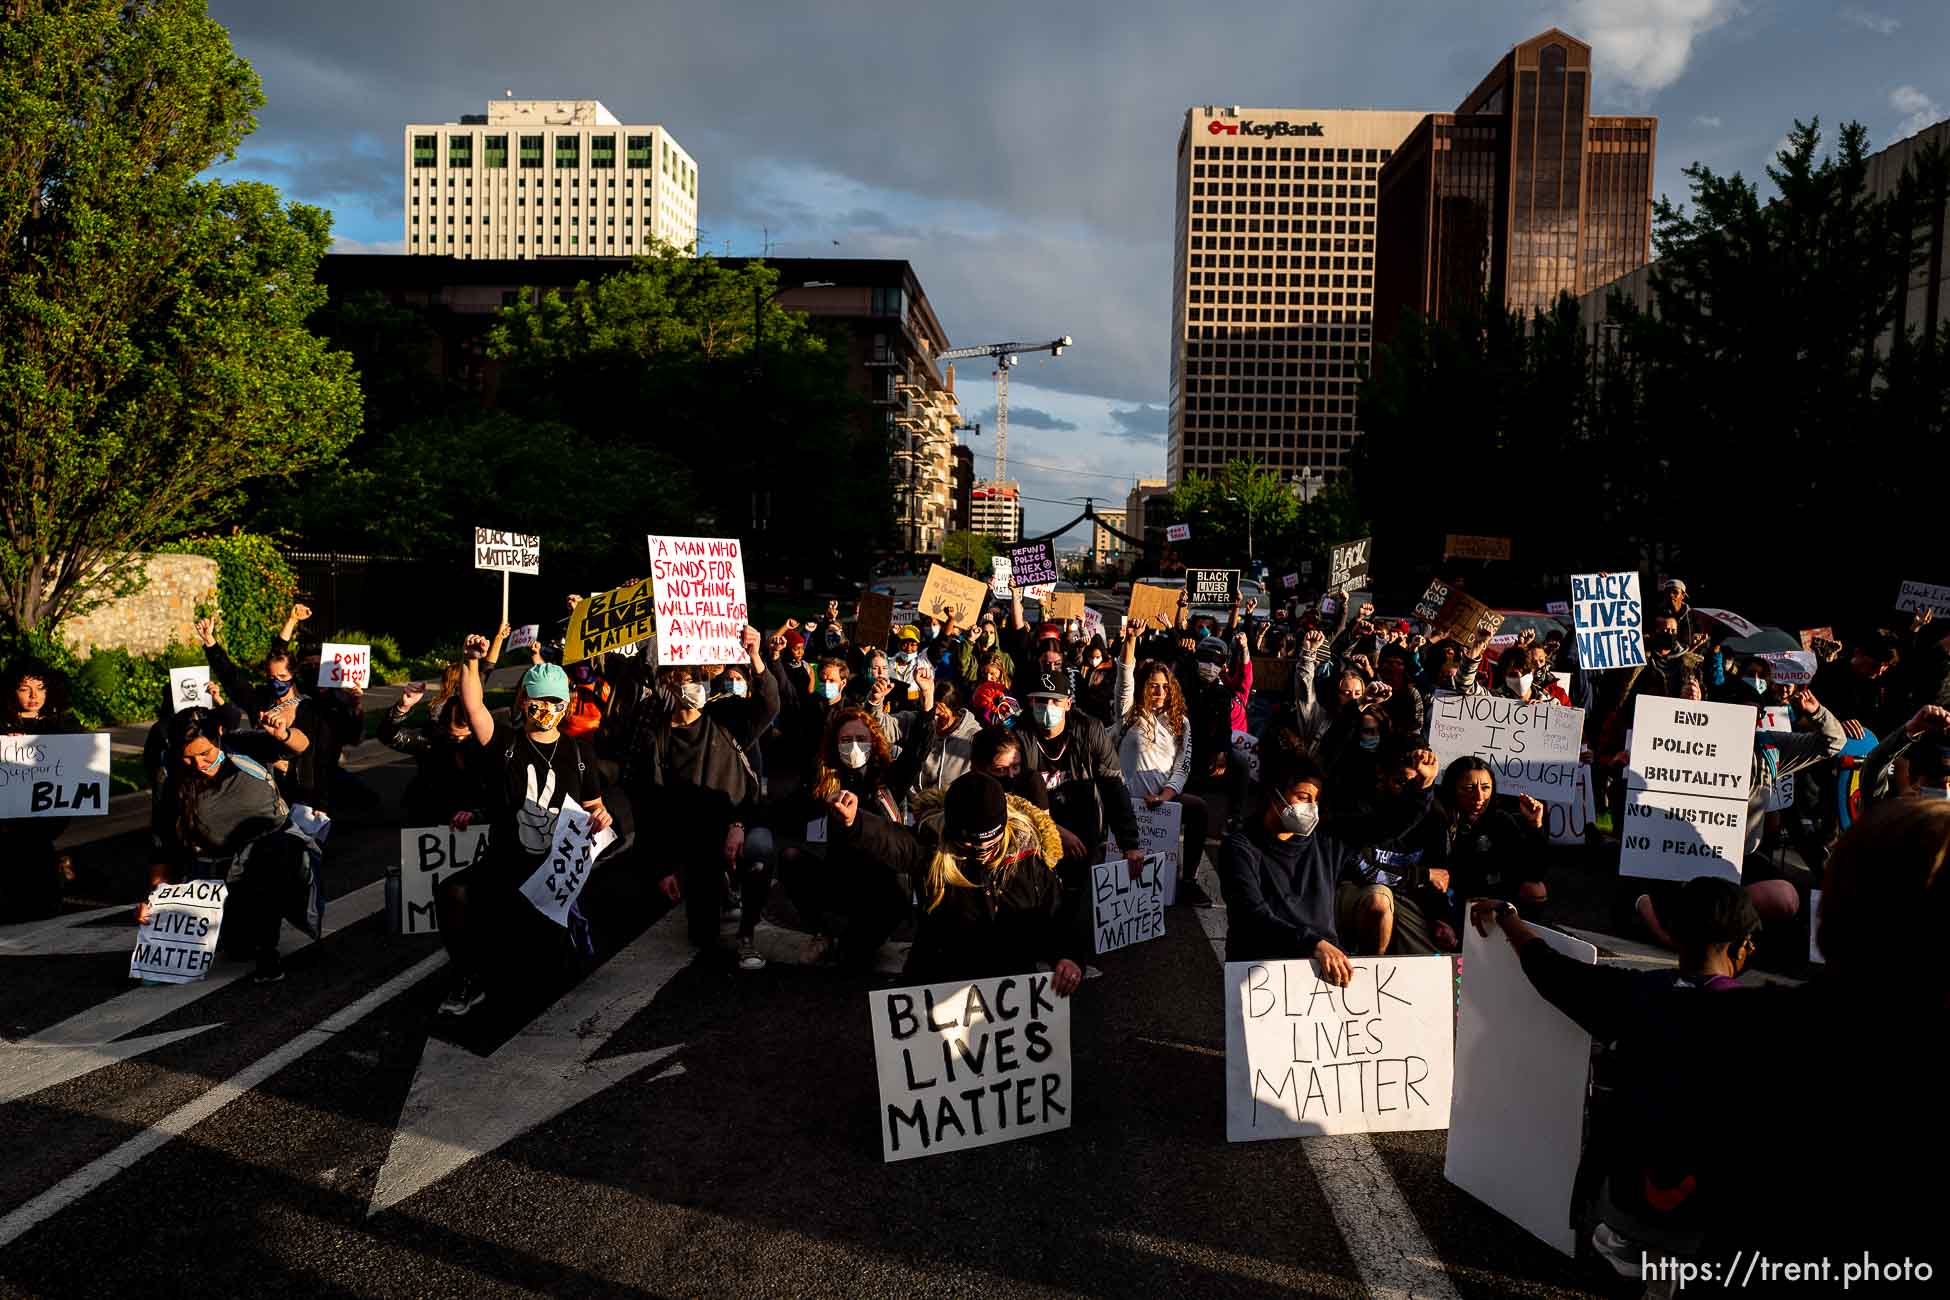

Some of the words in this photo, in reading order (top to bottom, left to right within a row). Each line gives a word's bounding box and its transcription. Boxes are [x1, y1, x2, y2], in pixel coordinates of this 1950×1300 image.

[1240, 120, 1324, 140] KeyBank
[477, 528, 508, 546] BLACK
[512, 531, 538, 549] LIVES
[674, 541, 705, 557] MAN
[708, 541, 737, 558] WHO
[1012, 544, 1046, 556] DEFUND
[477, 547, 520, 567] MATTER
[1014, 553, 1046, 566] POLICE
[1021, 562, 1042, 574] HEX
[1333, 541, 1367, 571] BLACK
[654, 559, 707, 580] STANDS
[708, 561, 735, 580] FOR
[1016, 570, 1057, 585] RACISTS
[1197, 572, 1229, 581] BLACK
[667, 580, 735, 603] NOTHING
[1193, 592, 1230, 602] MATTER
[1199, 582, 1225, 591] LIVES
[1430, 581, 1448, 596] NO
[1573, 575, 1631, 601] BLACK
[588, 581, 653, 617] BLA
[658, 601, 694, 616] WILL
[695, 601, 725, 617] FALL
[726, 603, 747, 620] FOR
[1574, 600, 1641, 628] LIVES
[1577, 628, 1645, 668] MATTER
[1441, 696, 1549, 729] ENOUGH
[1674, 710, 1709, 726] END
[1482, 725, 1526, 753] IS
[1652, 737, 1717, 757] POLICE
[1644, 766, 1742, 788] BRUTALITY
[31, 781, 101, 812] BLM
[1627, 802, 1652, 817] NO
[1664, 807, 1738, 827] JUSTICE
[418, 833, 490, 872] BLA
[1625, 835, 1650, 850] NO
[1662, 839, 1723, 859] PEACE
[158, 883, 225, 902] BLACK
[1096, 894, 1160, 929] LIVES
[153, 913, 209, 937] LIVES
[1099, 911, 1162, 952] MATTER
[134, 943, 214, 970] MATTER
[1248, 964, 1412, 1018] BLACK
[887, 976, 1054, 1040] BLACK
[1292, 1018, 1383, 1063] LIVES
[902, 1021, 1053, 1091] LIVES
[1252, 1056, 1430, 1128] MATTER
[887, 1073, 1066, 1151] MATTER
